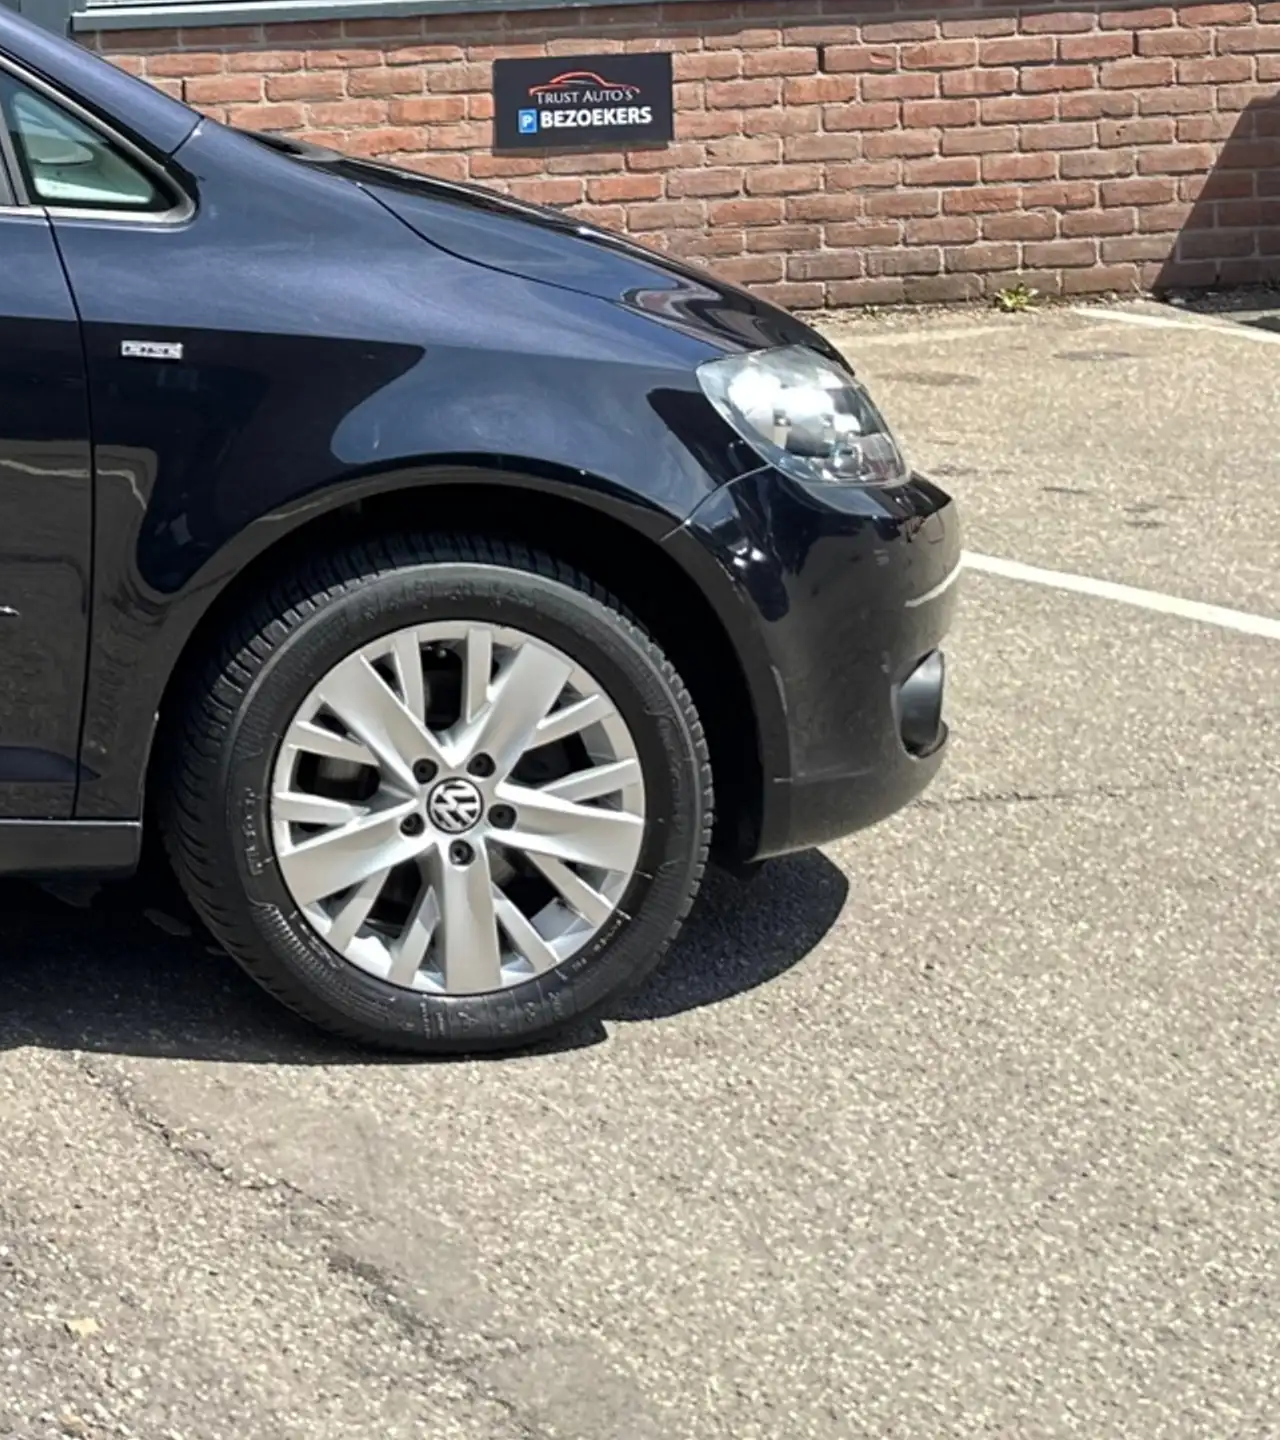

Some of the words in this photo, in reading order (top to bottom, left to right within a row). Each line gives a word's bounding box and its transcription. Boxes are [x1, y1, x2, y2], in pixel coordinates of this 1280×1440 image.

[536, 91, 580, 105] TRUST
[582, 89, 634, 104] AUTO'S
[540, 106, 653, 129] BEZOEKERS
